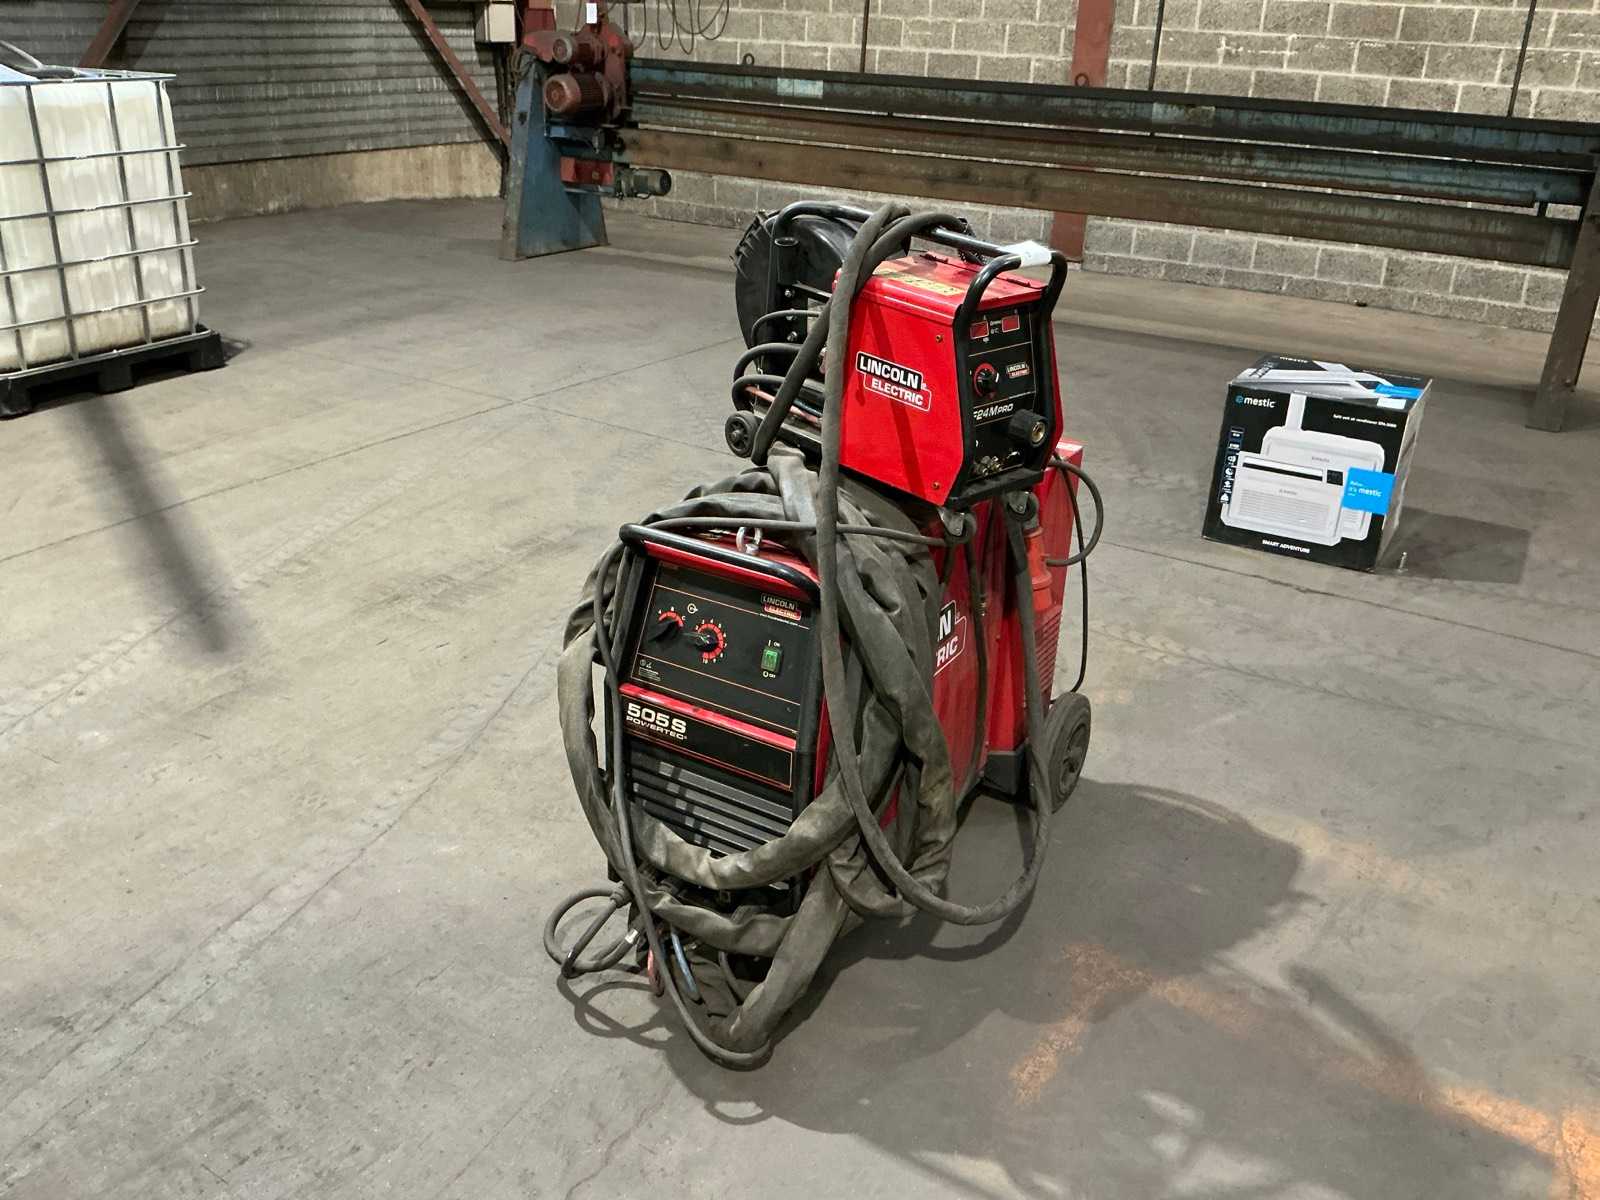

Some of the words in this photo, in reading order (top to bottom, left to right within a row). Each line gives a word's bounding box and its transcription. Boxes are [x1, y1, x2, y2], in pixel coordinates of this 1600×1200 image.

[859, 355, 920, 390] LINCOLN
[871, 377, 924, 406] ELECTRIC
[1243, 397, 1276, 409] mestic
[1358, 488, 1383, 498] mestic
[1262, 539, 1281, 547] SMART
[1279, 543, 1311, 554] ADVENTURE
[763, 595, 796, 611] LINCOLN
